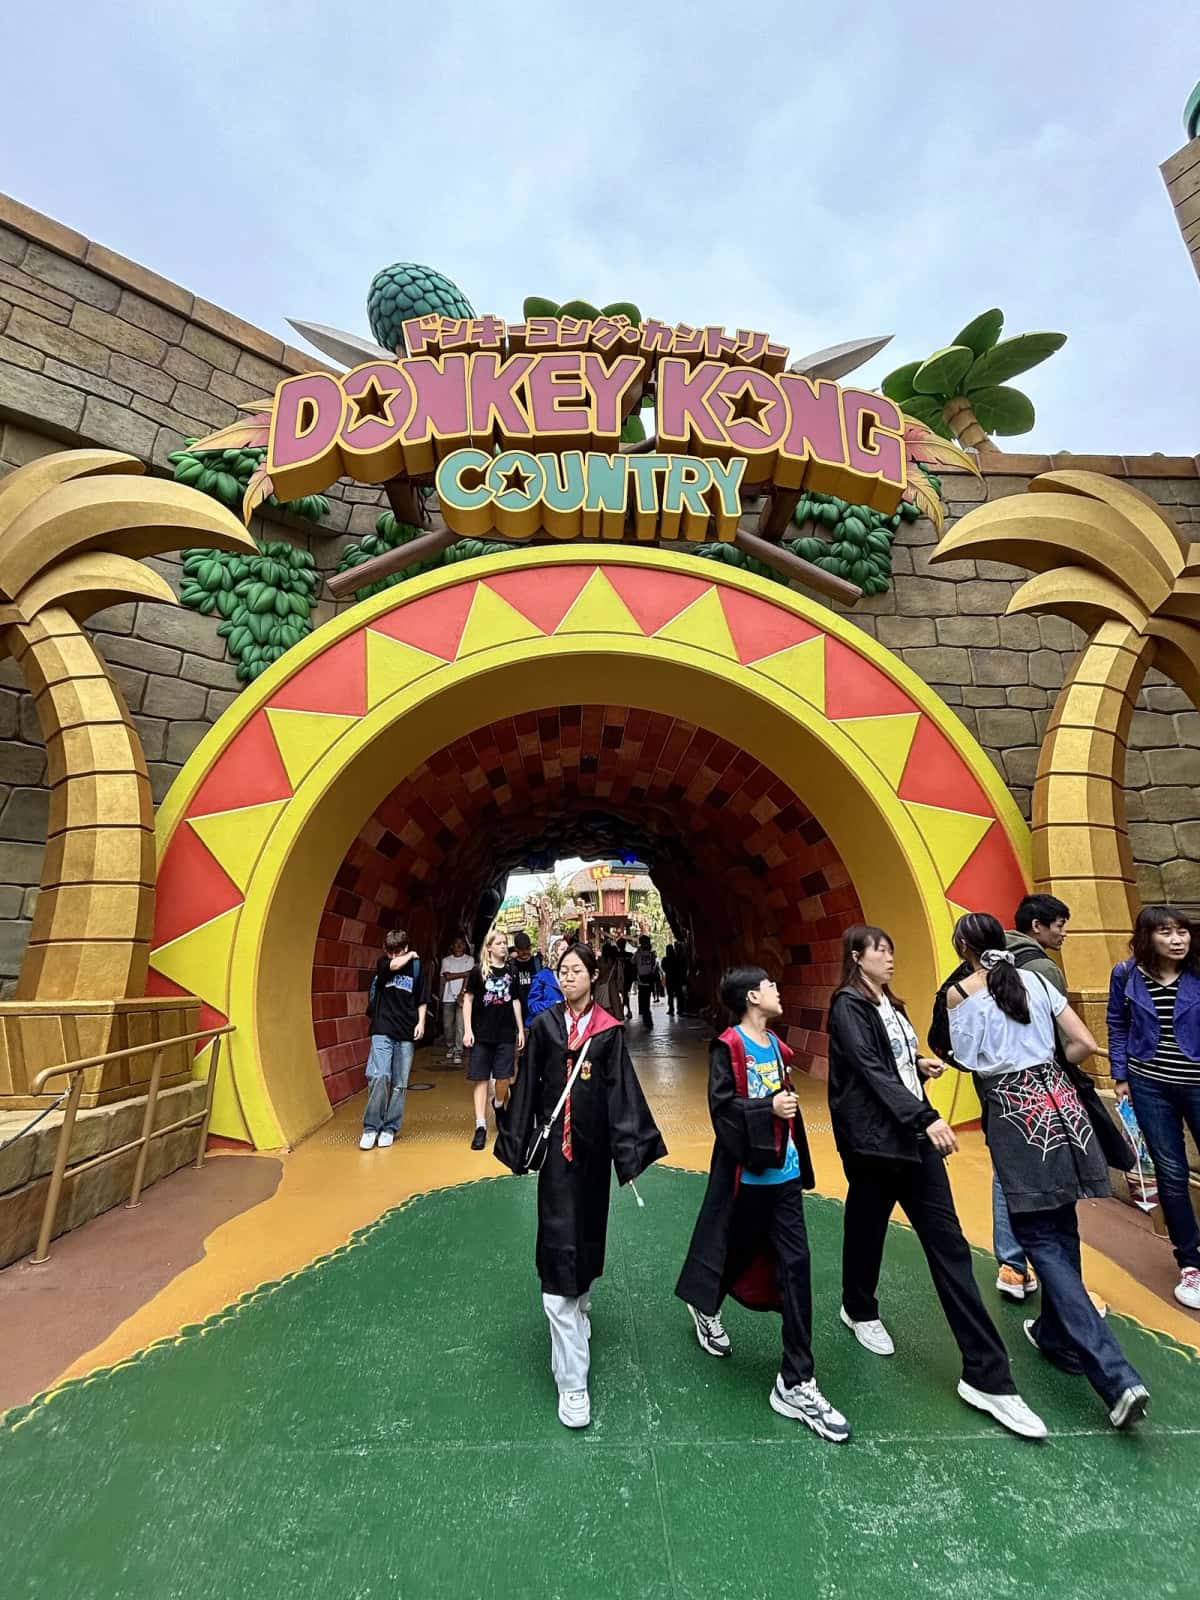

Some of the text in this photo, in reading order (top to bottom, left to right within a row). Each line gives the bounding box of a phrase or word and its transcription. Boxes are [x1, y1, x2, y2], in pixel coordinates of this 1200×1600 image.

[402, 313, 790, 363] ドンキーコング・カントリー
[267, 352, 908, 487] DONKEY KONG
[436, 447, 748, 516] COUNTRY
